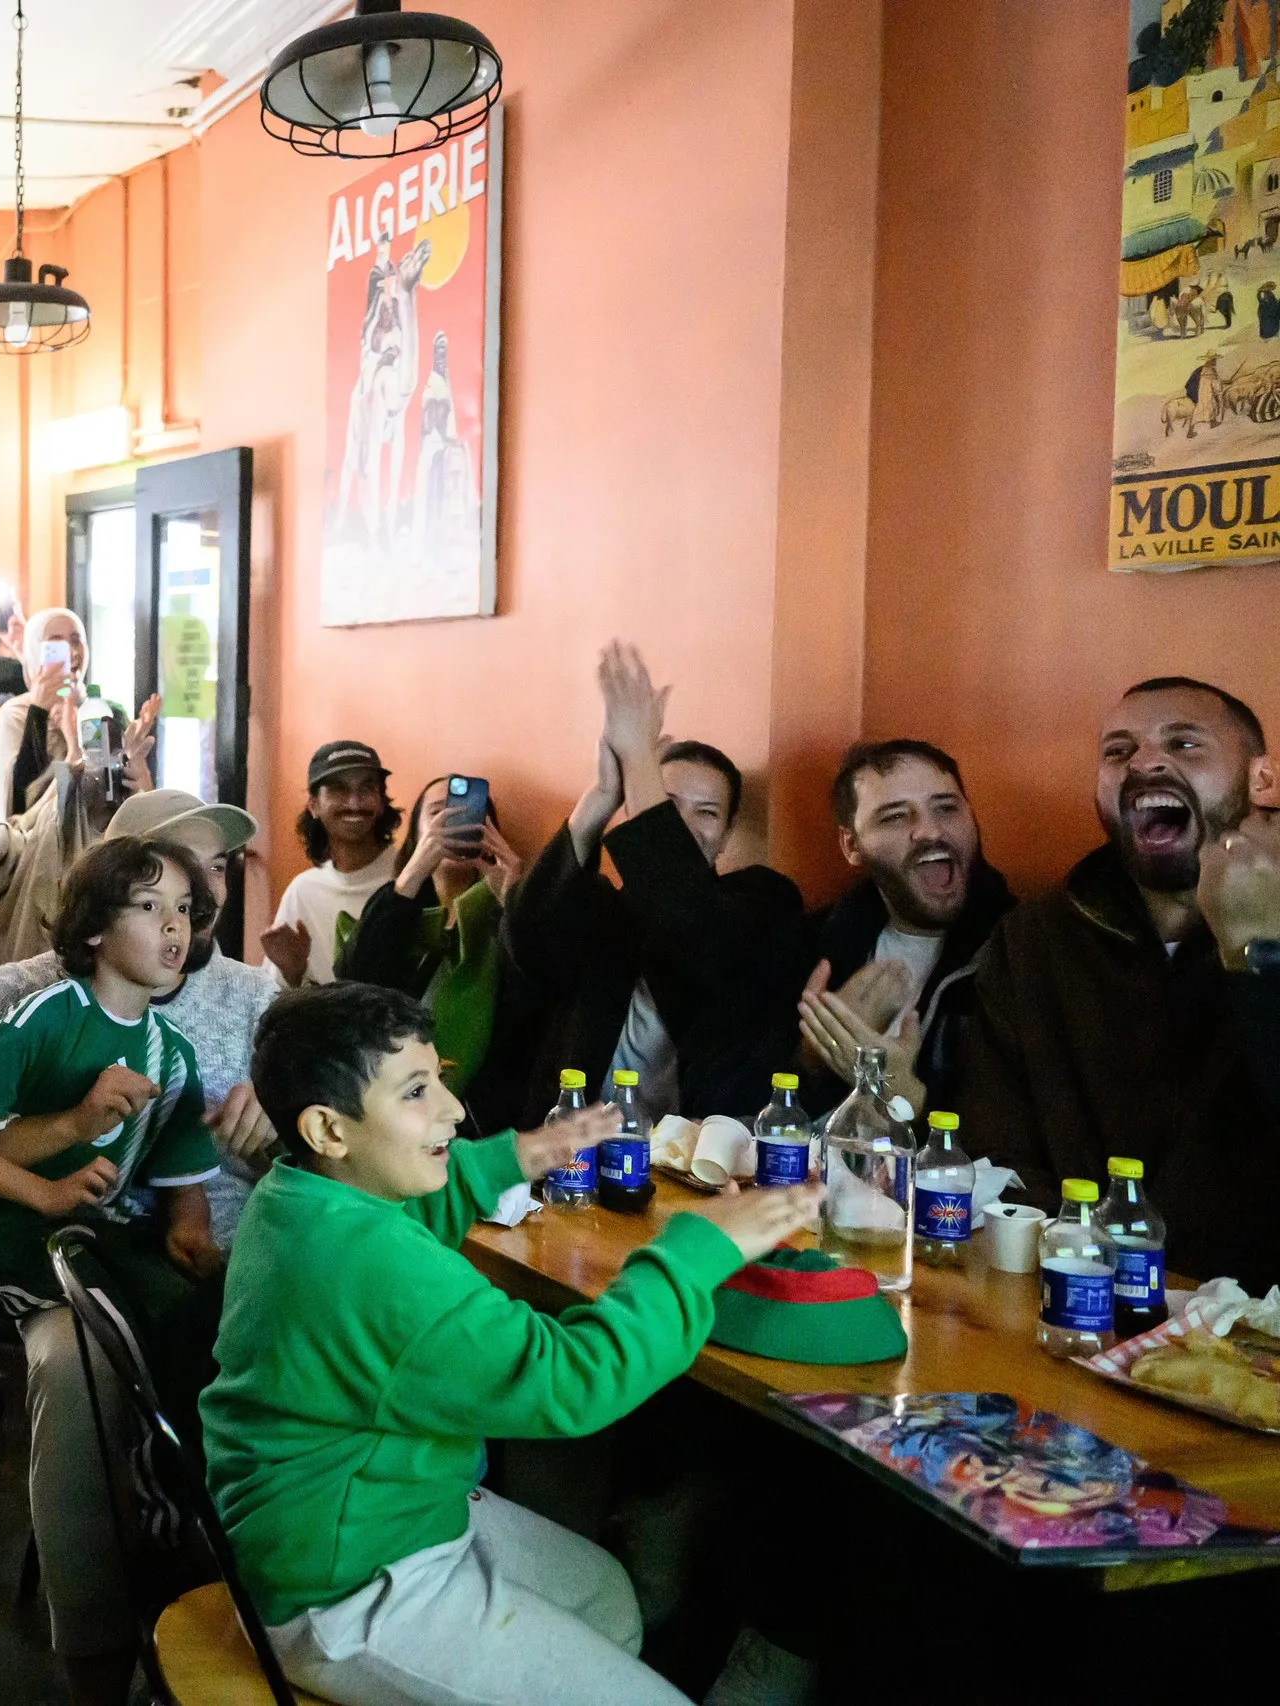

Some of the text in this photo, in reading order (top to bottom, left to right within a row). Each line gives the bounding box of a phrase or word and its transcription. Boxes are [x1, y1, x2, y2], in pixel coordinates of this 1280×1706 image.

[327, 127, 487, 271] ALGERIE
[1119, 543, 1146, 560] LA
[1152, 536, 1216, 556] VILLE
